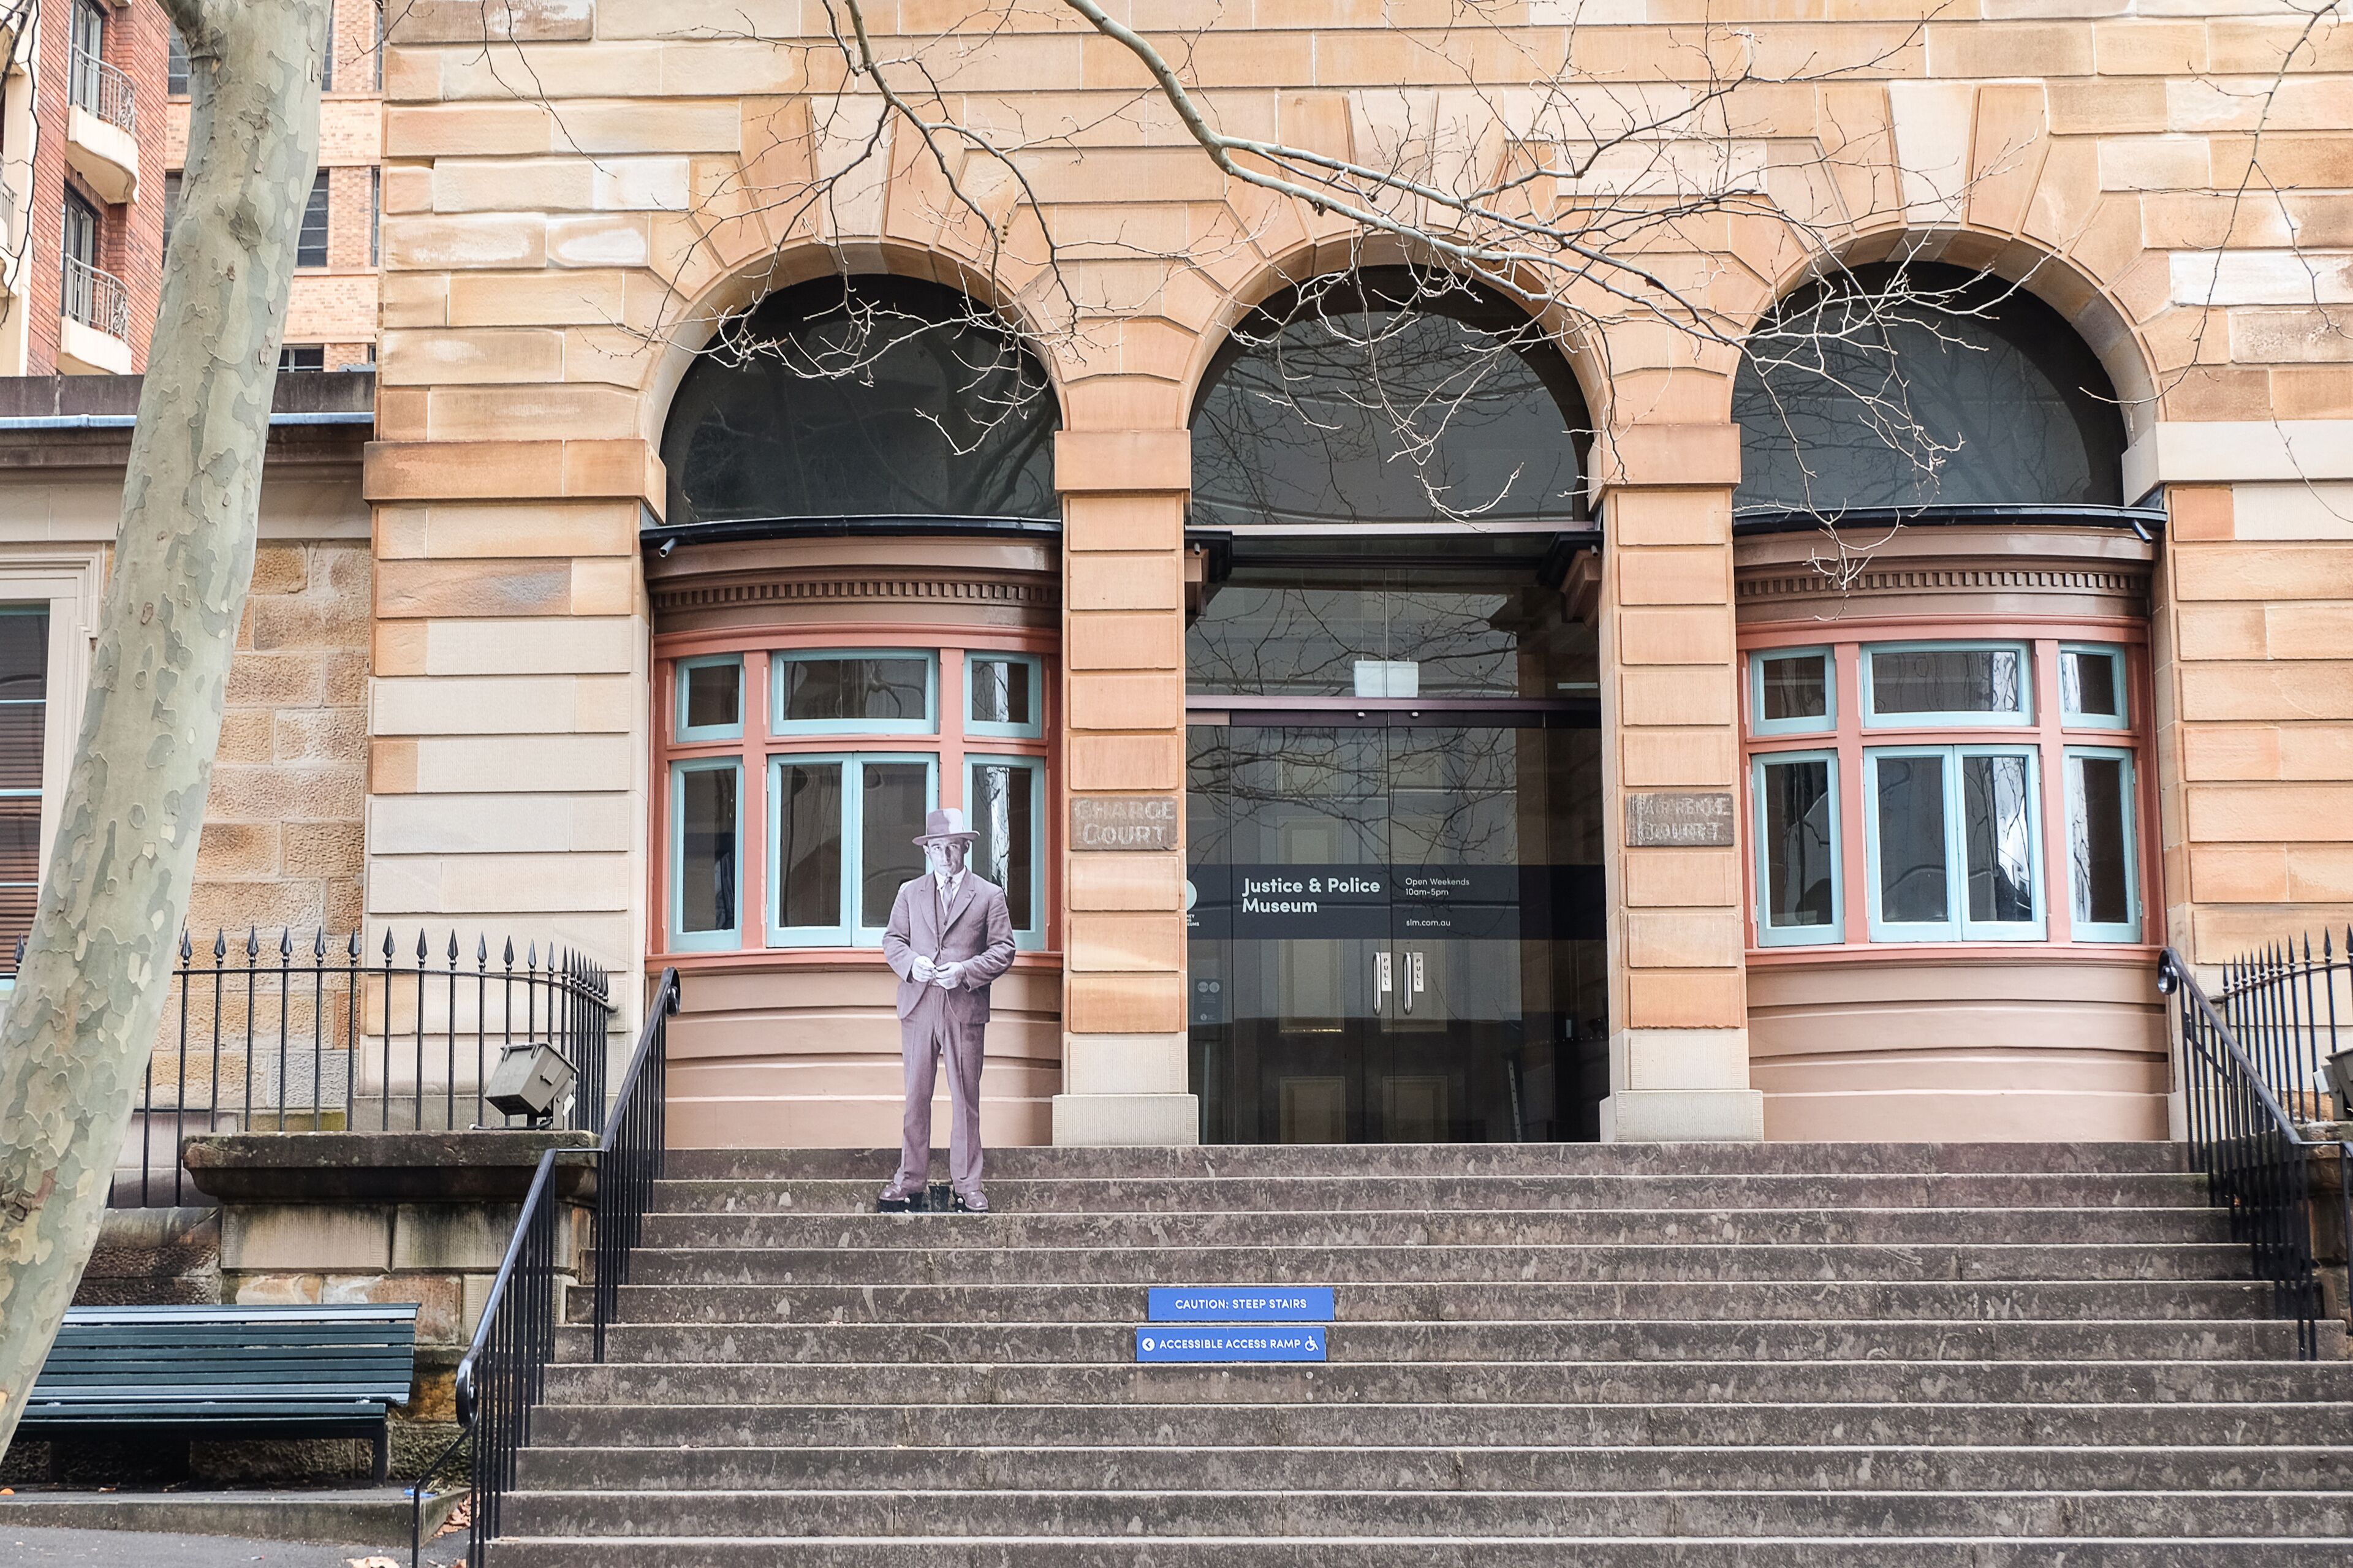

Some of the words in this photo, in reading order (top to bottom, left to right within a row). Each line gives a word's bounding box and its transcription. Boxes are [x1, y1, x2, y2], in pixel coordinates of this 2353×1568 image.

[1082, 822, 1167, 845] COURT
[1241, 877, 1303, 897] Justice
[1309, 877, 1322, 893] &
[1328, 877, 1381, 893] Police
[1405, 877, 1428, 887] Open
[1406, 888, 1449, 897] 10am-5pm
[1242, 898, 1317, 913] Museum
[1175, 1299, 1229, 1309] CAUTION:
[1232, 1299, 1267, 1309] STEEP
[1269, 1298, 1307, 1309] STAIRS
[1159, 1339, 1223, 1349] ACCESSIBLE
[1226, 1339, 1267, 1349] ACCESS
[1270, 1339, 1302, 1349] RAMP
